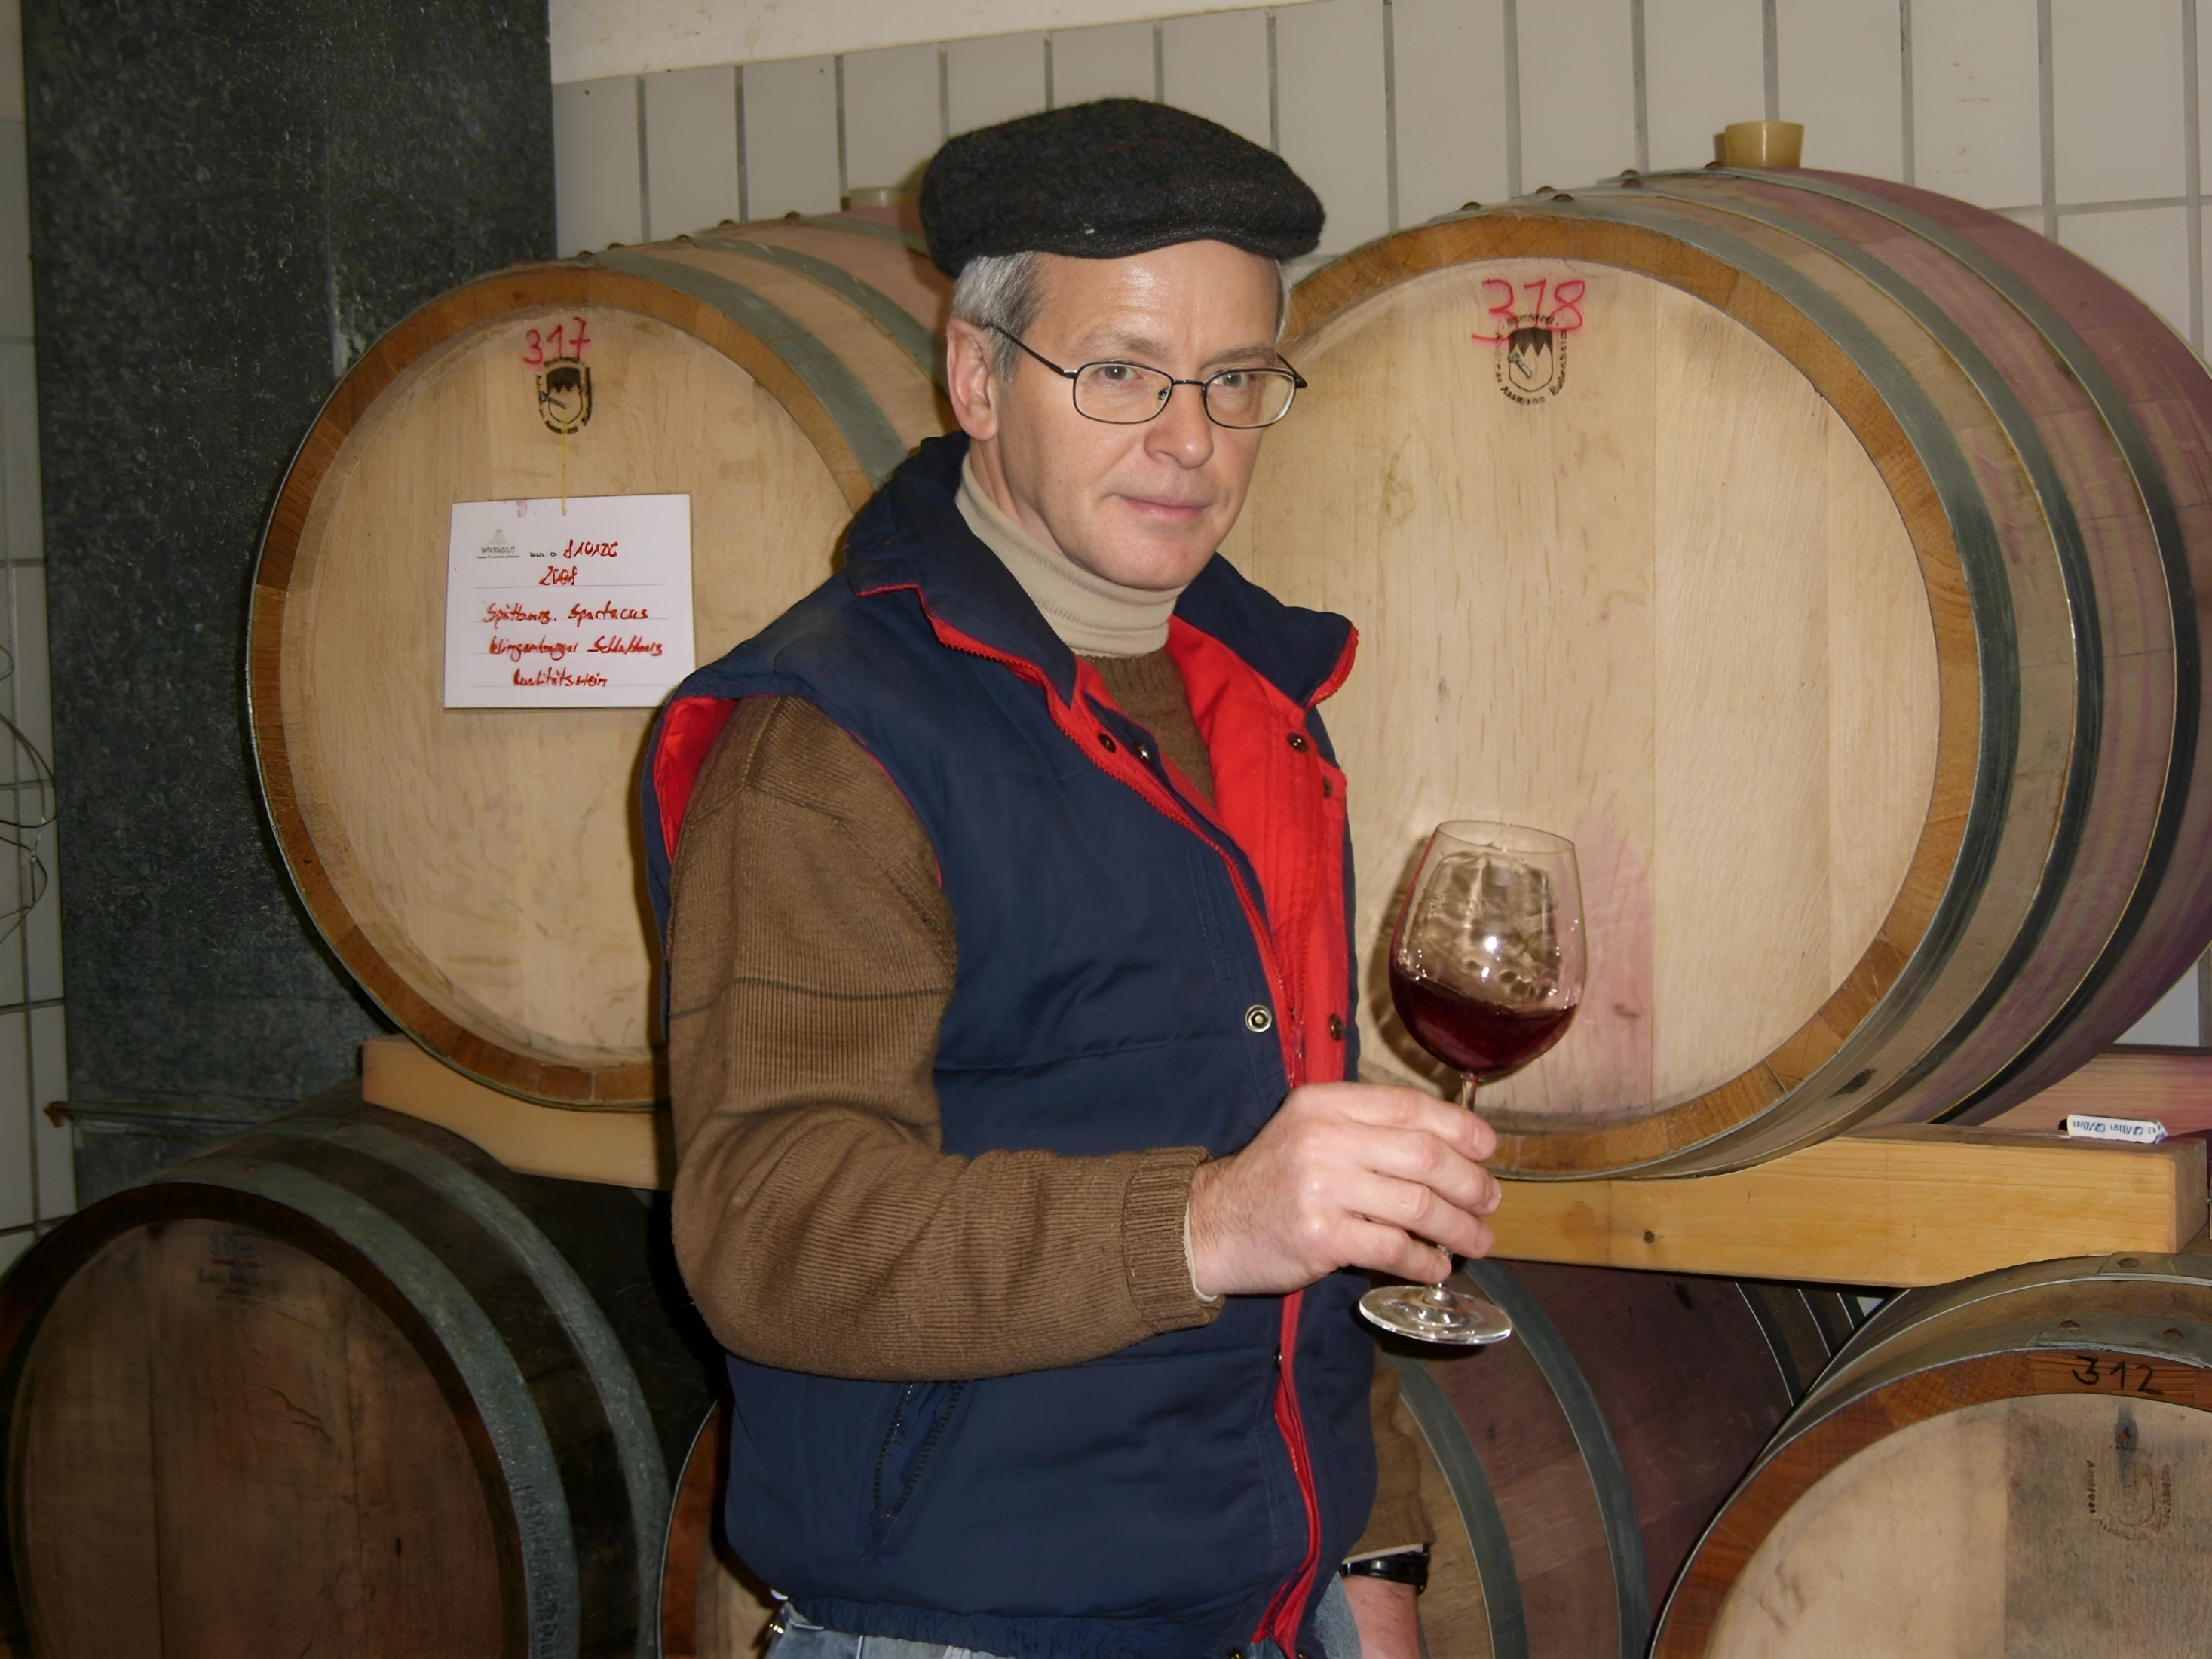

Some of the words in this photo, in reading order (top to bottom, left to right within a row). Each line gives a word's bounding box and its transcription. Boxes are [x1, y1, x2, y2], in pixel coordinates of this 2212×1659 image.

[1472, 278, 1585, 342] 318
[523, 316, 591, 365] 317
[2072, 1355, 2164, 1395] 312
